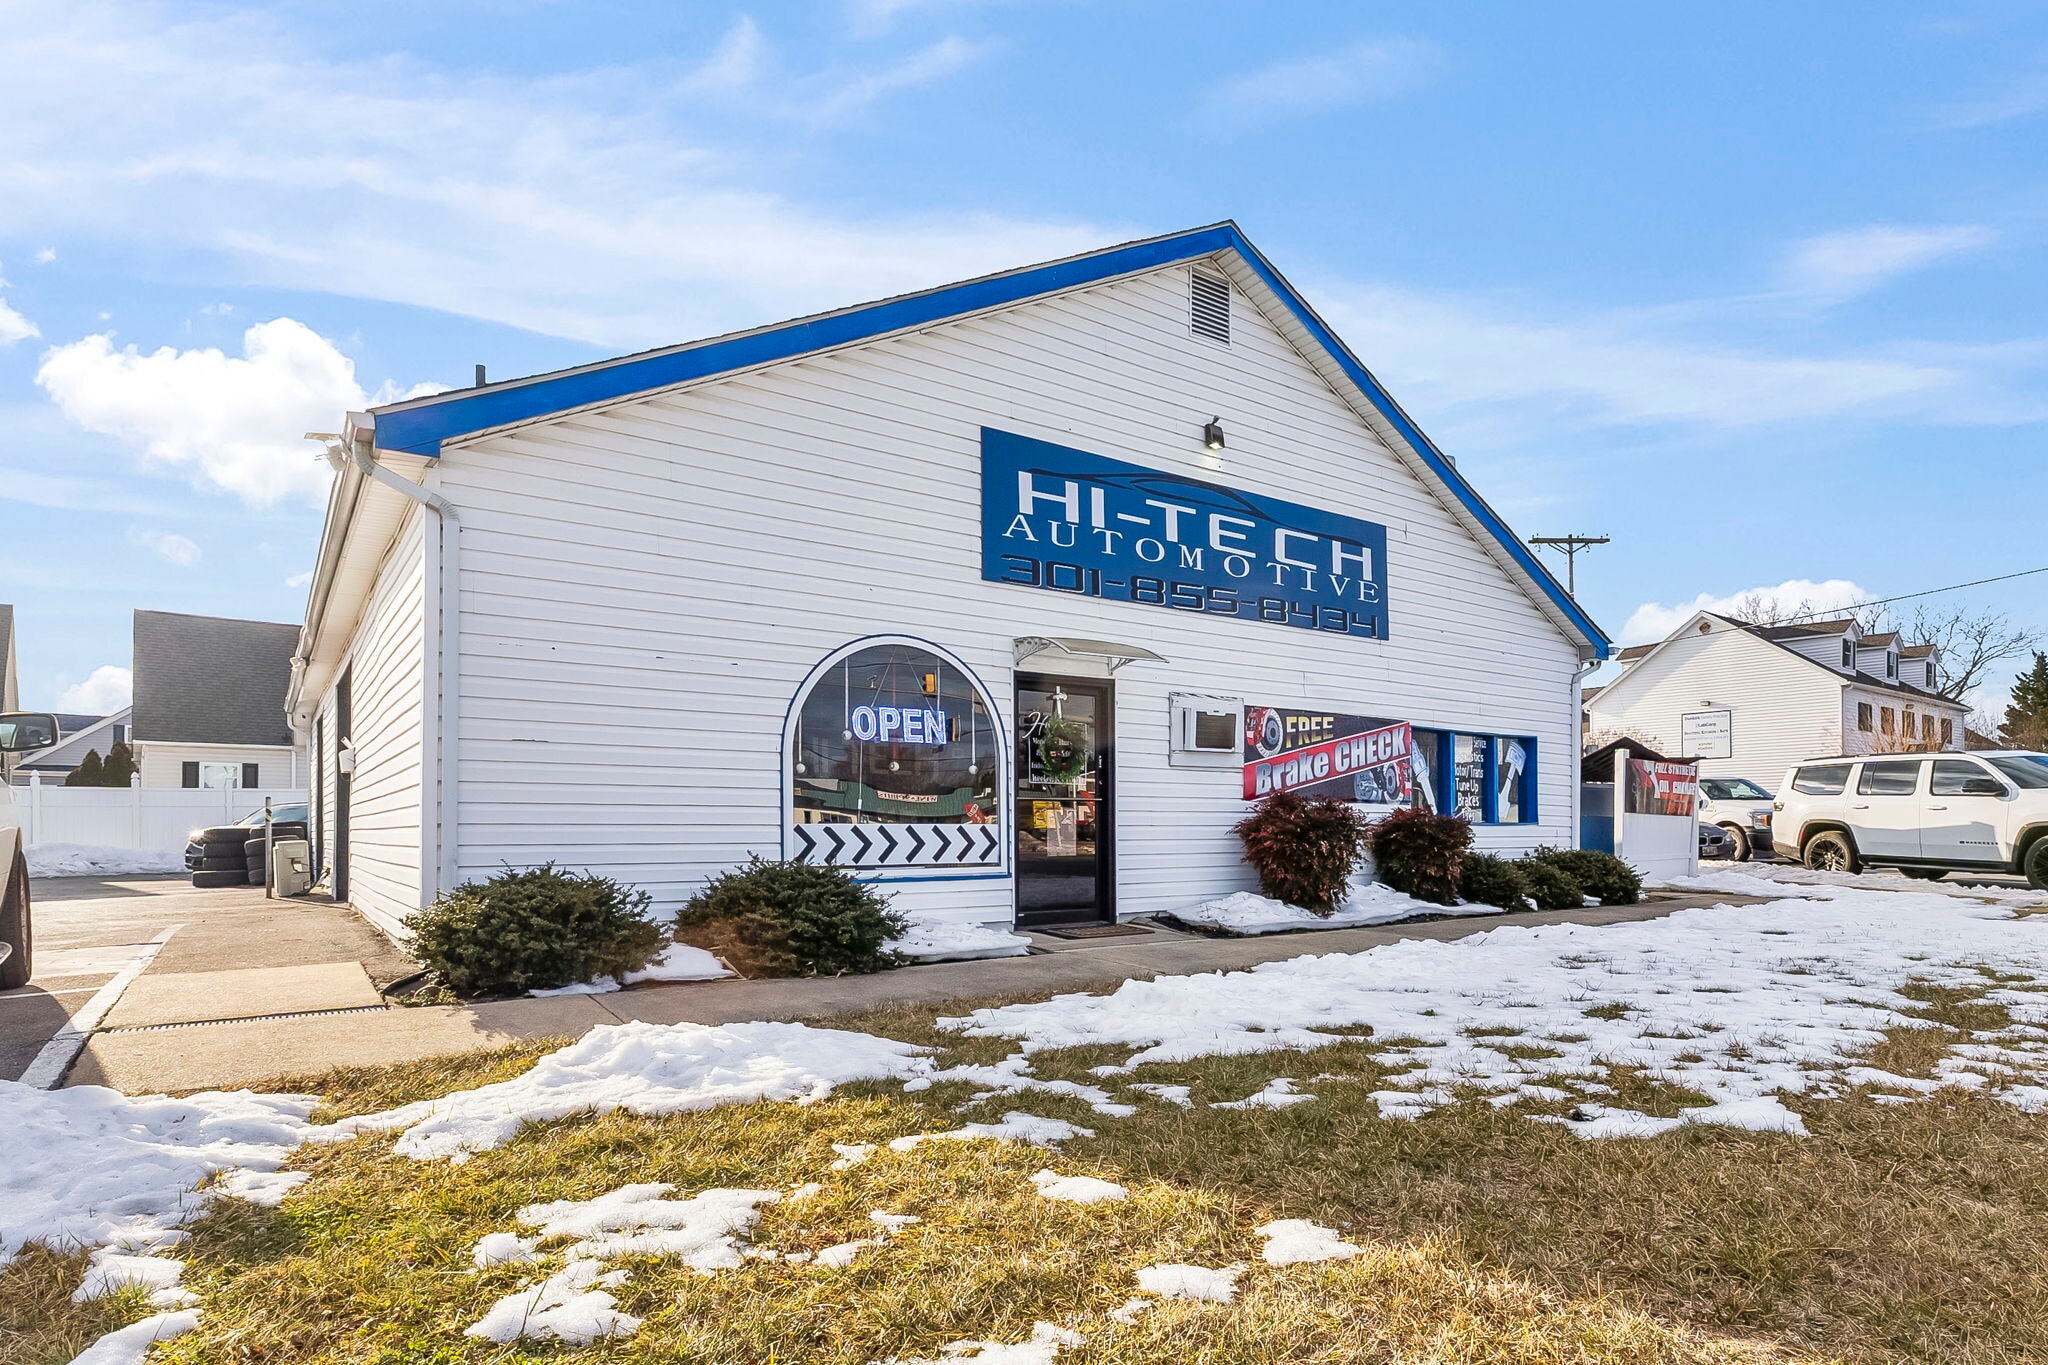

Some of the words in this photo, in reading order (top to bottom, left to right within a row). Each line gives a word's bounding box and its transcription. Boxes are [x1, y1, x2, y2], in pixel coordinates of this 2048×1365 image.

[1018, 471, 1373, 582] HI-TECH
[1002, 514, 1380, 604] AUTOMOTIVE
[1001, 554, 1379, 639] 301-855-8434
[852, 705, 947, 745] OPEN
[1286, 716, 1335, 748] FREE
[1255, 751, 1330, 796] Brake
[1334, 726, 1406, 773] CHECK
[1455, 778, 1470, 791] Tune
[1470, 778, 1479, 795] Up
[1457, 792, 1480, 807] Brakes
[1659, 780, 1670, 793] OIL
